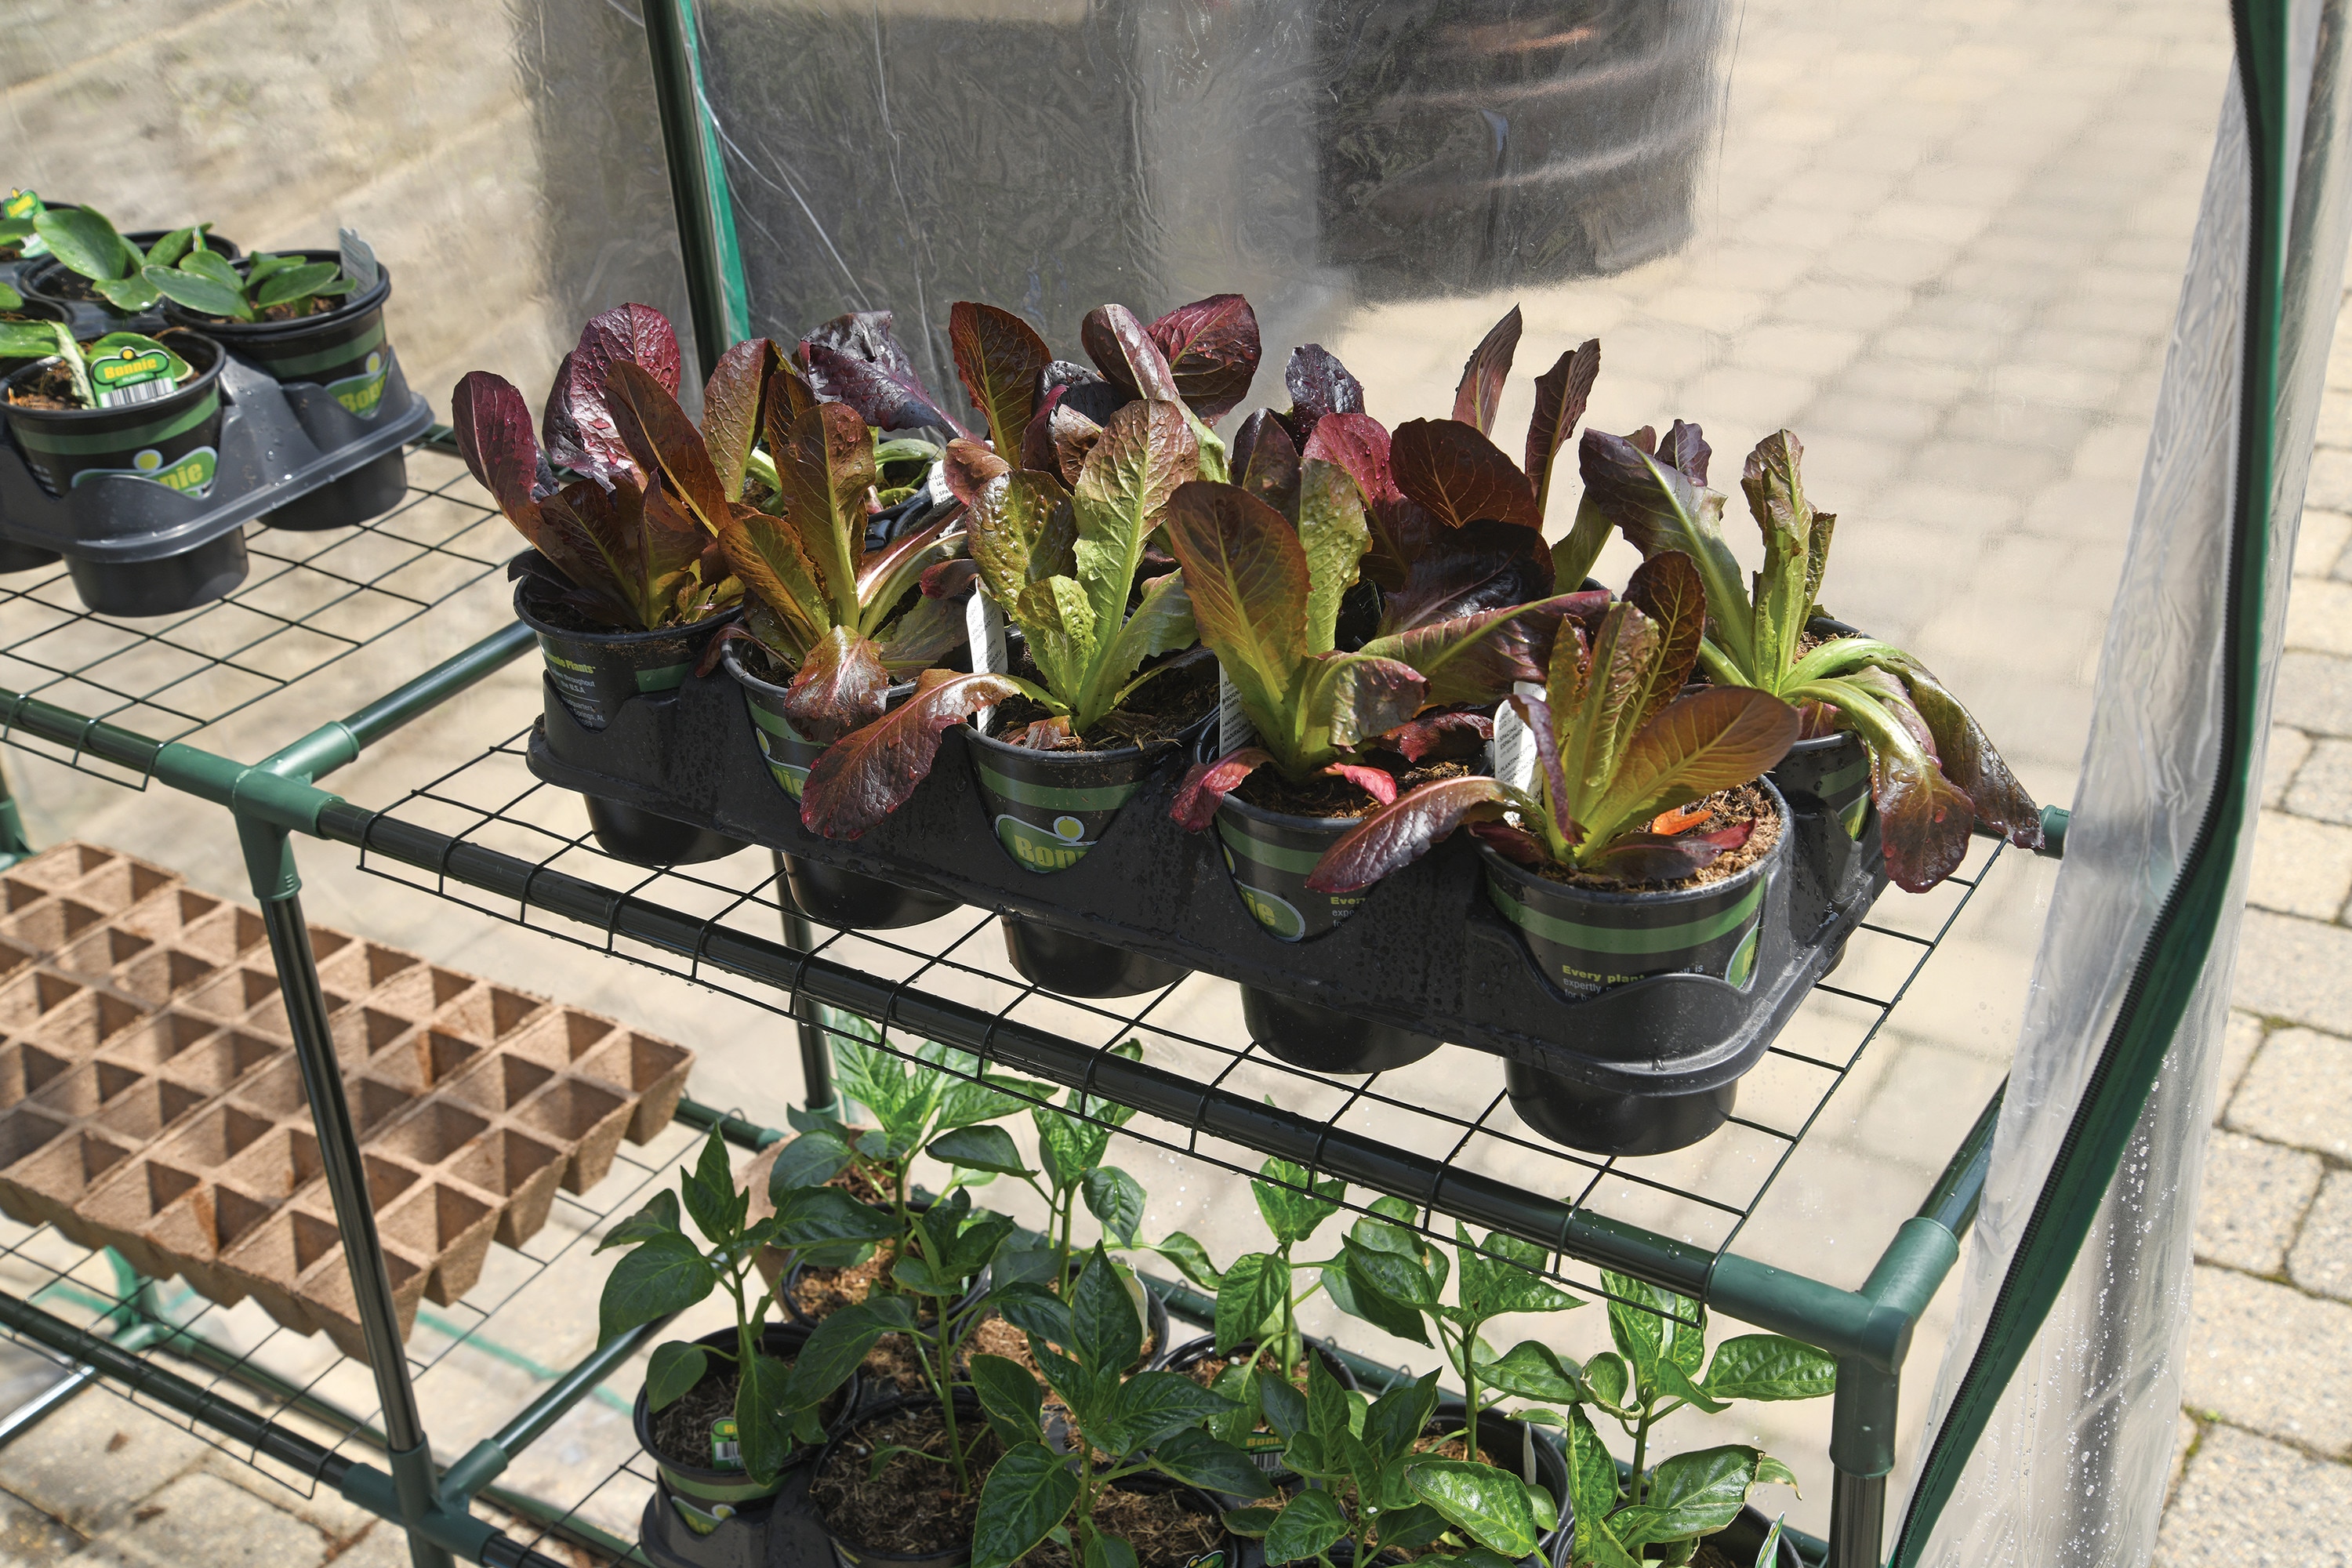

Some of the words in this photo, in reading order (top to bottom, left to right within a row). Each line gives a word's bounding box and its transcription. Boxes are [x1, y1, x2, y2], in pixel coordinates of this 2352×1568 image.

[103, 358, 157, 379] Bonnie
[1014, 835, 1088, 869] Bon
[1563, 965, 1602, 982] Every
[1563, 978, 1602, 994] expertly
